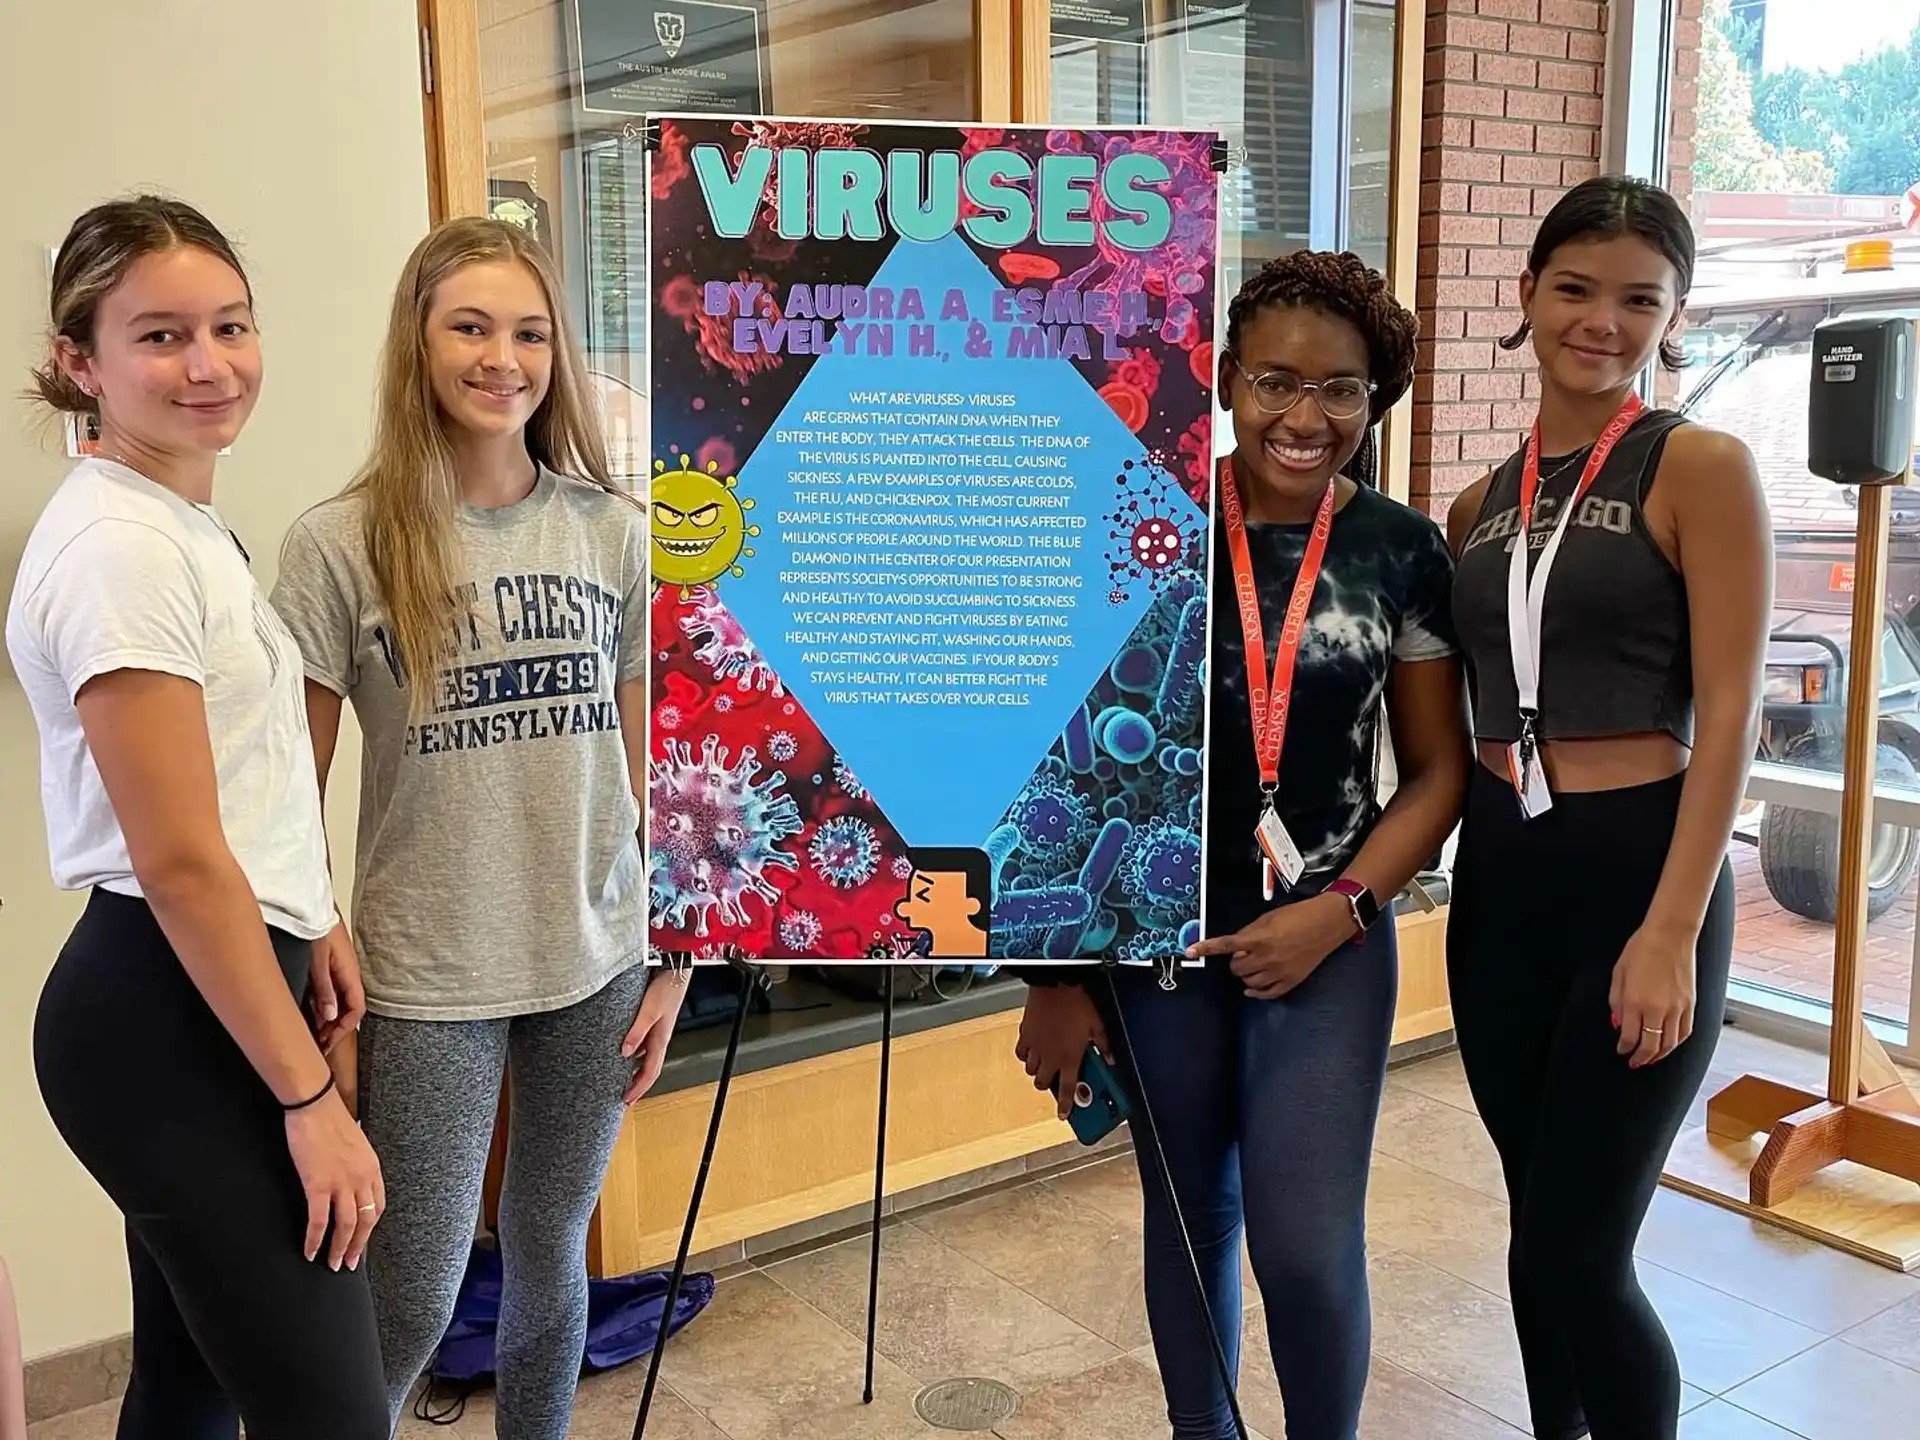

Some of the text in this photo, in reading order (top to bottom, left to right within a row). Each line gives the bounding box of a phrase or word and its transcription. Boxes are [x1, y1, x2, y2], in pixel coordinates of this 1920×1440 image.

[700, 70, 727, 80] AWARD
[690, 143, 1175, 252] VIRUSES
[703, 281, 772, 318] BY:
[784, 284, 926, 321] AUDRA
[991, 287, 1114, 325] ESME
[732, 318, 894, 357] EVELYN
[962, 320, 993, 359] &
[1005, 326, 1091, 361] MIA
[1830, 346, 1854, 354] HAND
[1822, 353, 1863, 363] SANITIZER
[849, 392, 886, 404] WHAT
[888, 393, 912, 404] ARE
[968, 394, 1016, 406] VIRUSES
[803, 411, 827, 423] ARE
[827, 411, 870, 424] GERMS
[869, 412, 902, 424] THAT
[903, 412, 958, 425] CONTAIN
[989, 413, 1028, 426] WHEN
[1029, 414, 1060, 427] THEY
[774, 431, 813, 443] ENTER
[816, 432, 839, 444] THE
[879, 433, 910, 445] THEY
[909, 433, 956, 446] ATTACK
[958, 434, 982, 446] THE
[1021, 435, 1044, 448] THE
[1045, 435, 1073, 448] DNA
[1074, 436, 1090, 448] OF
[798, 452, 822, 463] THE
[823, 452, 858, 464] VIRUS
[859, 452, 871, 464] IS
[872, 453, 926, 465] PLANTED
[927, 454, 957, 466] INTO
[957, 454, 982, 466] THE
[1014, 455, 1066, 468] CAUSING
[846, 473, 856, 485] A
[857, 474, 883, 485] FEW
[884, 474, 944, 486] EXAMPLES
[945, 475, 962, 487] OF
[962, 475, 1010, 488] VIRUSES
[1011, 476, 1034, 488] ARE
[794, 493, 818, 504] THE
[845, 493, 873, 504] AND
[956, 495, 979, 506] THE
[980, 495, 1014, 507] MOST
[1015, 496, 1069, 508] CURRENT
[777, 513, 831, 524] EXAMPLE
[833, 513, 843, 524] IS
[846, 514, 869, 524] THE
[959, 515, 1002, 527] WHICH
[1004, 516, 1029, 527] HAS
[1029, 516, 1086, 528] AFFECTED
[782, 533, 837, 544] MILLIONS
[838, 533, 854, 544] OF
[856, 534, 898, 545] PEOPLE
[899, 534, 952, 546] AROUND
[953, 535, 977, 546] THE
[1029, 536, 1051, 547] THE
[1053, 536, 1081, 548] BLUE
[792, 553, 1071, 567] DIAMOND IN THE CENTER OF OUR PRESENTATION
[779, 572, 850, 584] REPRESENTS
[908, 574, 999, 586] OPPORTUNITIES
[1002, 575, 1018, 586] TO
[1019, 575, 1033, 586] BE
[1034, 576, 1082, 587] STRONG
[782, 593, 810, 603] AND
[811, 593, 865, 604] HEALTHY
[868, 594, 884, 604] TO
[884, 594, 923, 605] AVOID
[924, 594, 1002, 606] SUCCUMBING
[1005, 595, 1021, 606] TO
[1237, 573, 1261, 644] CLEMSON
[1283, 579, 1311, 646] CLEMSON
[494, 573, 623, 664] CHESTE
[793, 613, 1068, 626] WE CAN PREVENT AND FIGHT VIRUSES BY EATING
[785, 632, 838, 644] HEALTHY
[840, 633, 868, 644] AND
[869, 633, 920, 645] STAYING
[942, 634, 1001, 646] WASHING
[1001, 635, 1028, 646] OUR
[801, 652, 829, 663] AND
[830, 653, 881, 664] GETTING
[882, 653, 909, 664] OUR
[972, 654, 982, 665] IF
[983, 654, 1016, 665] YOUR
[810, 672, 845, 683] STAYS
[905, 673, 915, 684] IT
[917, 673, 943, 684] CAN
[945, 674, 986, 685] BETTER
[988, 674, 1022, 685] FIGHT
[1025, 674, 1047, 686] THE
[824, 692, 858, 704] VIRUS
[861, 693, 890, 704] THAT
[895, 693, 929, 704] TAKES
[930, 693, 961, 704] OVER
[963, 694, 996, 705] YOUR
[403, 700, 620, 756] PENNSYLVANI
[1266, 689, 1288, 761] CLEMSON
